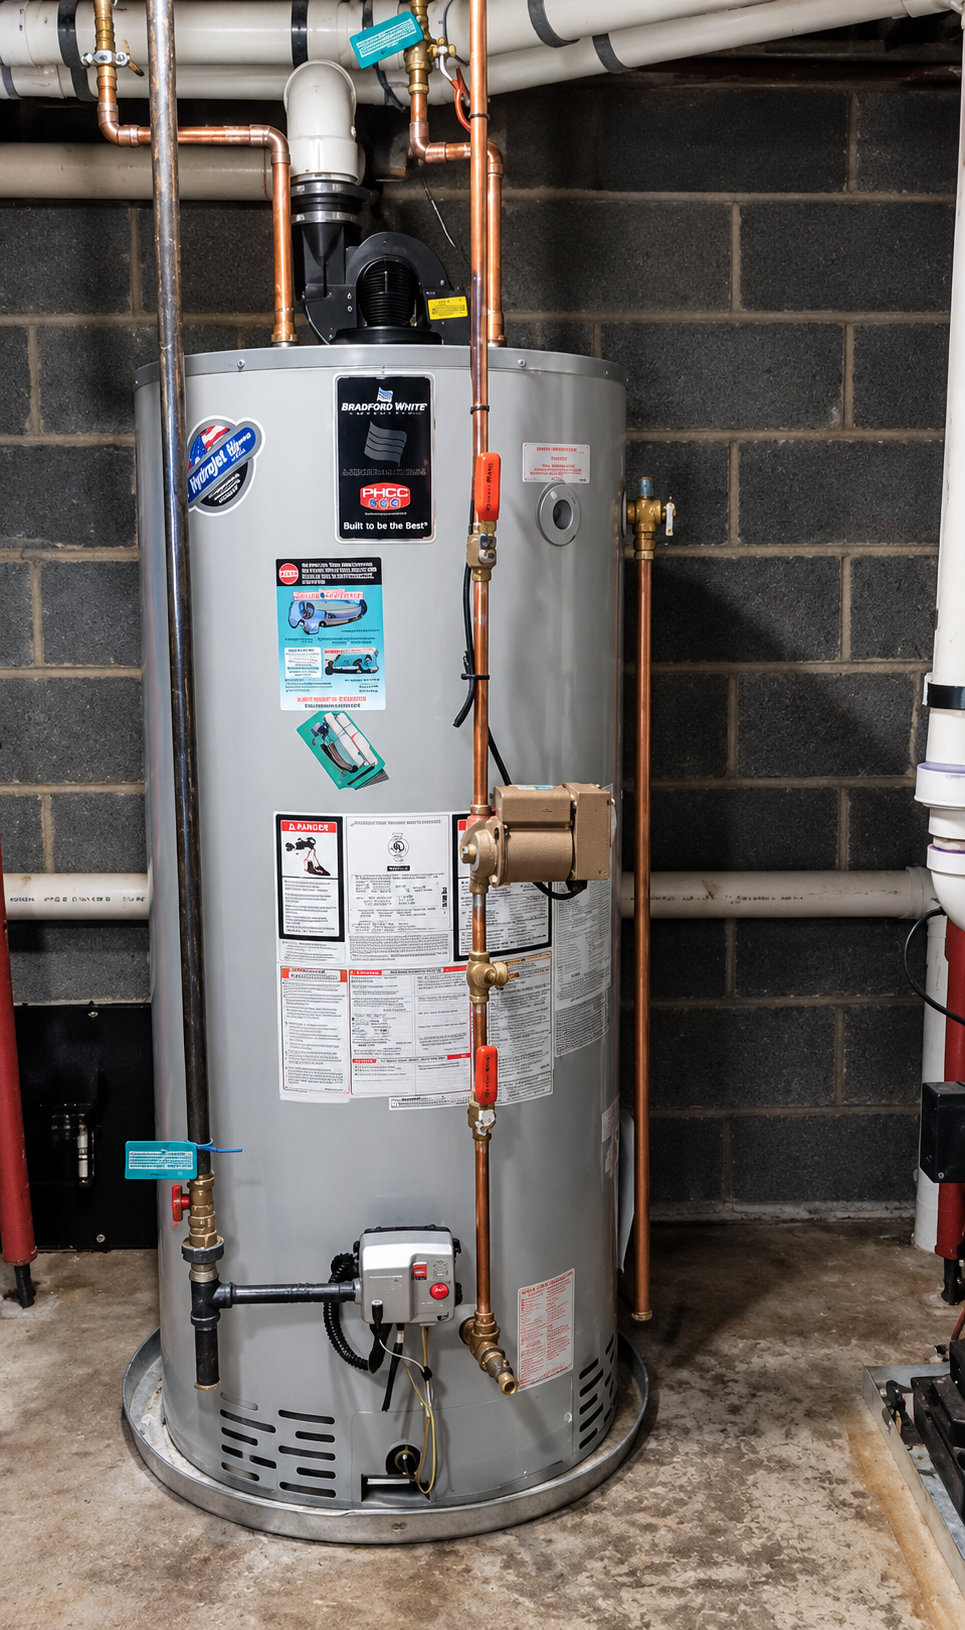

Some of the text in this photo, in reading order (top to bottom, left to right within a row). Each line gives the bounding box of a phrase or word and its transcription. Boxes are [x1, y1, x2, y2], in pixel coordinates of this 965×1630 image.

[341, 402, 428, 411] BRADFORD WHITE
[362, 488, 409, 498] PHCC
[343, 521, 363, 530] Built
[365, 522, 375, 530] to
[376, 521, 388, 530] be
[389, 521, 404, 530] the
